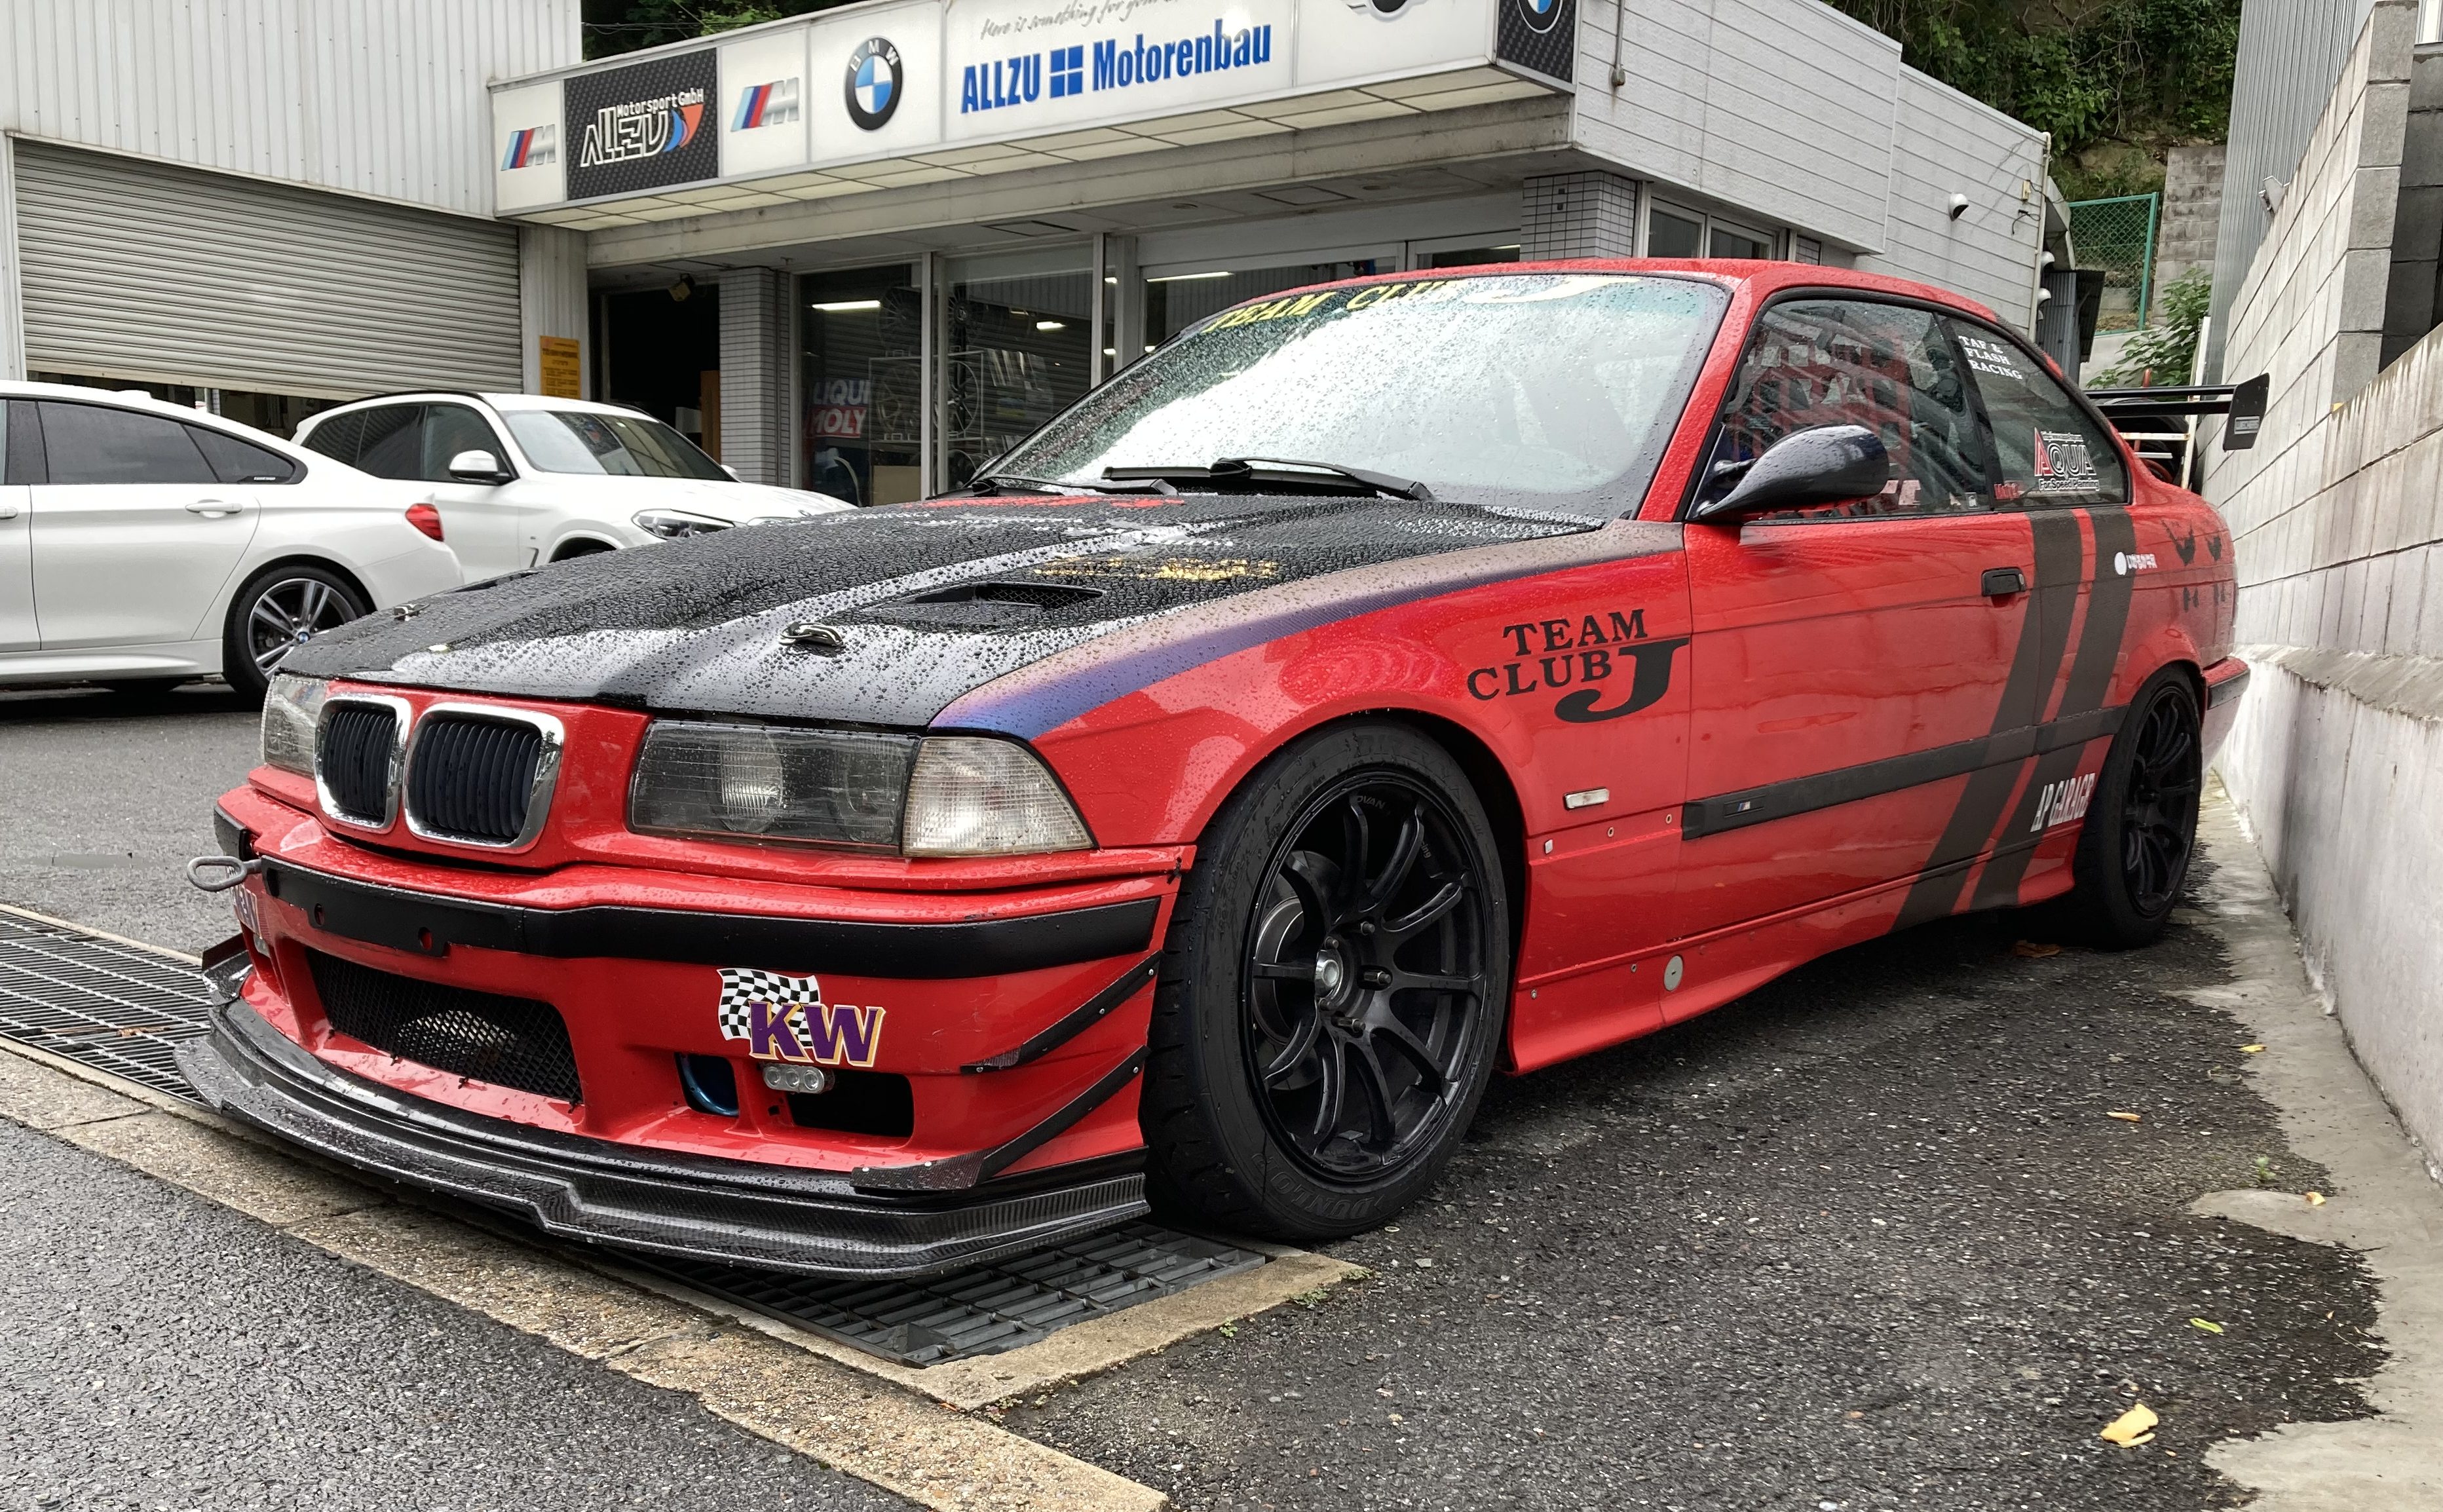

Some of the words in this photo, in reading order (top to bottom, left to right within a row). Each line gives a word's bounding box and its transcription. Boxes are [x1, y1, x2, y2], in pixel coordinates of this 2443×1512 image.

[850, 39, 899, 72] BMW
[961, 54, 1040, 114] ALLZU
[1093, 18, 1271, 91] Motorenbau
[617, 92, 677, 117] Motorsport
[677, 87, 704, 107] GmbH
[1963, 347, 2011, 365] FLASH
[1967, 360, 2022, 380] RACING
[2034, 427, 2096, 480] AQUA
[1503, 609, 1648, 656] TEAM
[1467, 650, 1612, 701] CLUB
[1554, 637, 1690, 723] J
[749, 1001, 886, 1067] KW
